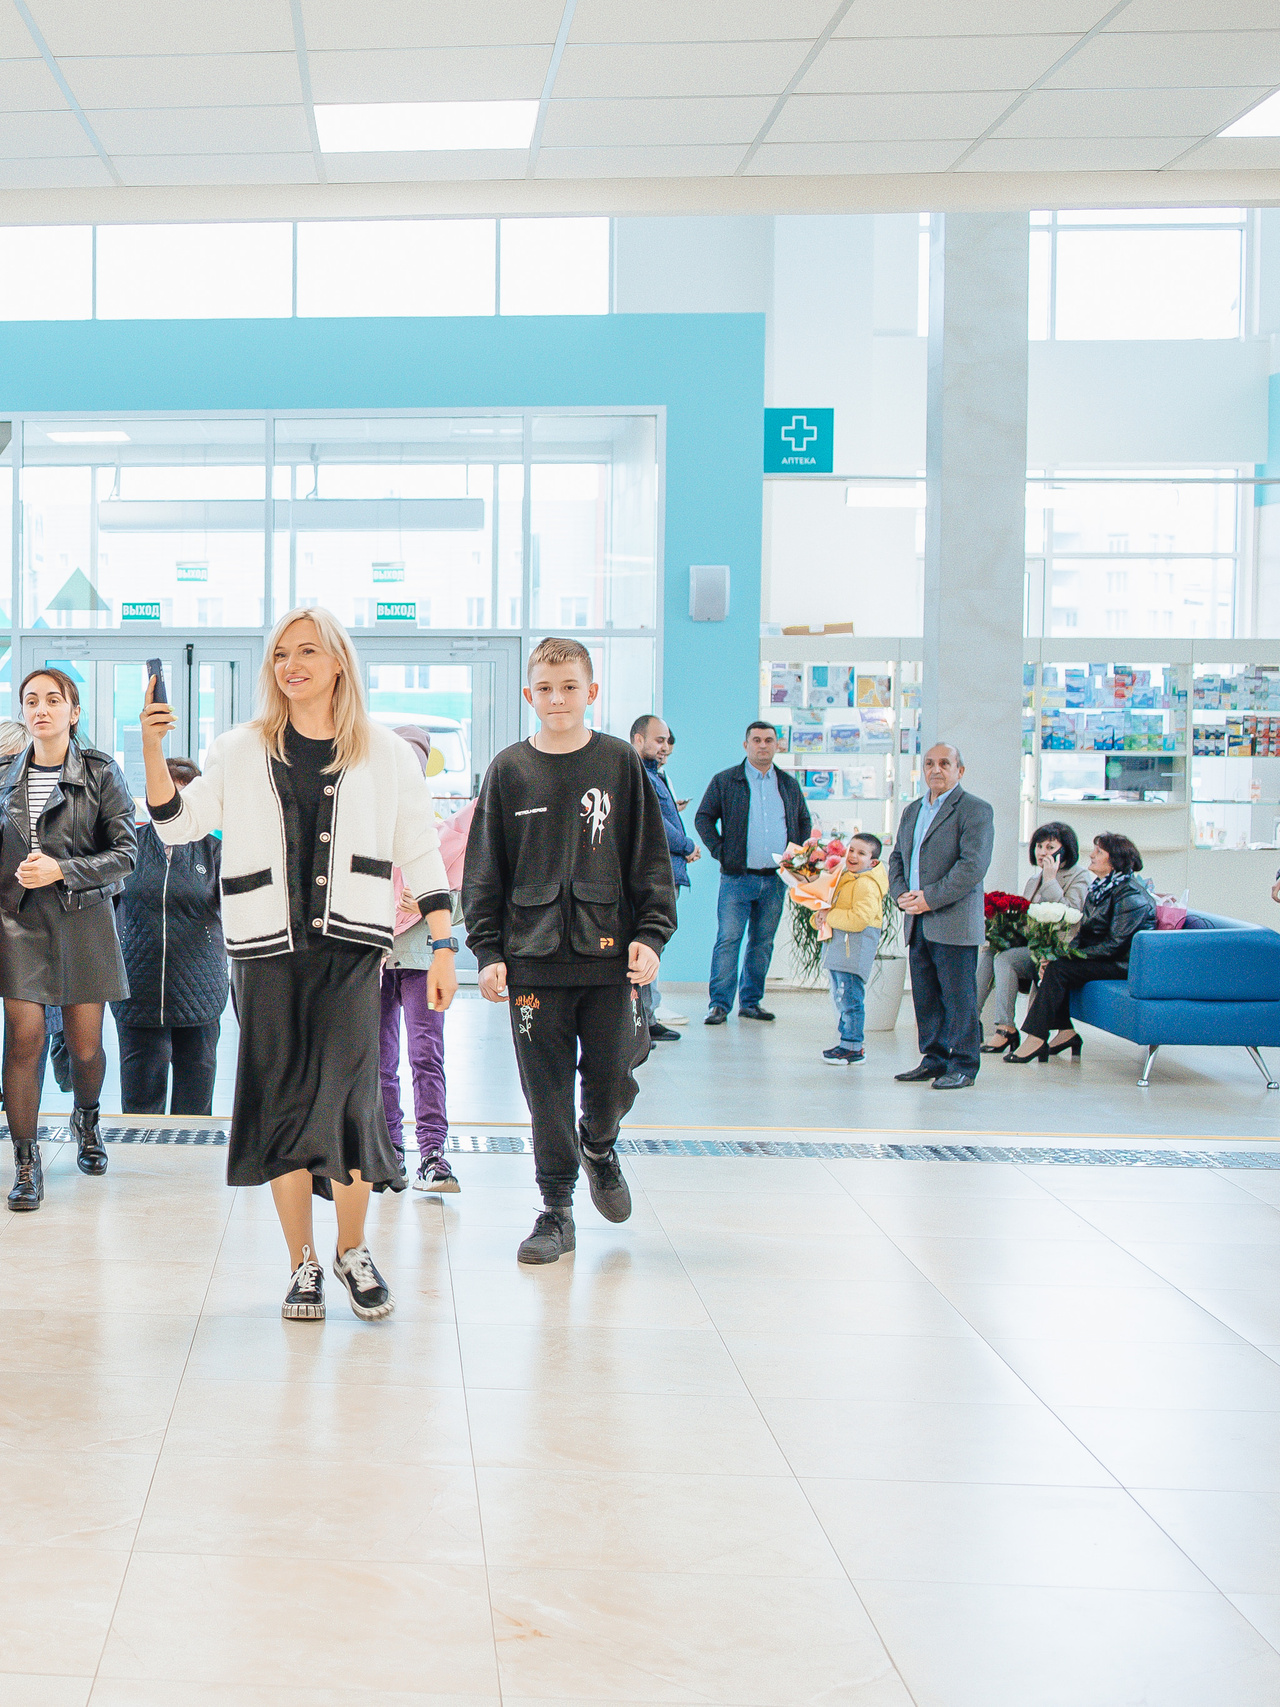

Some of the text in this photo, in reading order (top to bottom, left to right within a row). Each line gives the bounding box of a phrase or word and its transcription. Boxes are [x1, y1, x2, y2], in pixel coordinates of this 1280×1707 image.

[781, 456, 817, 465] АПТЕКА
[176, 568, 208, 581] ВЫХОД
[373, 569, 404, 581] ВЫХОД
[122, 604, 160, 618] ВЫХОД
[377, 604, 415, 618] ВЫХОД
